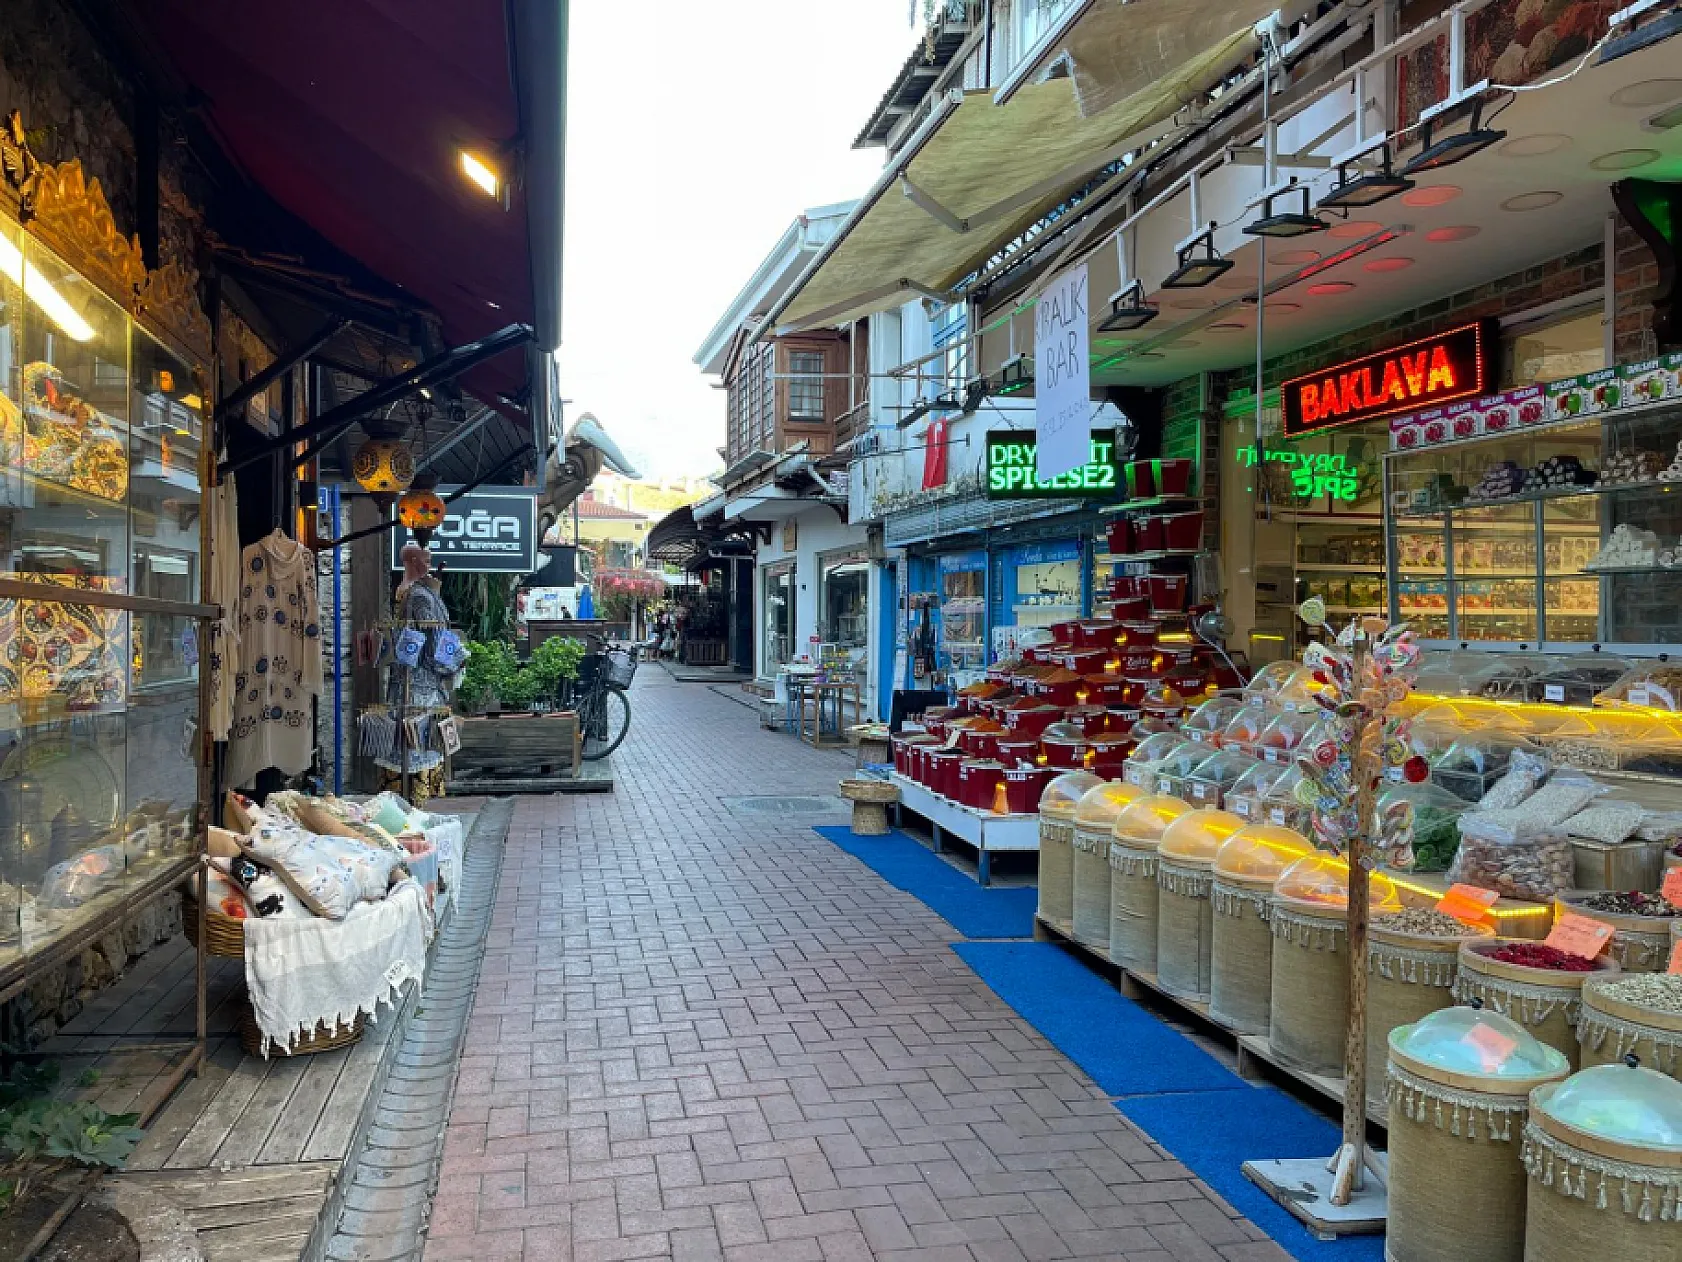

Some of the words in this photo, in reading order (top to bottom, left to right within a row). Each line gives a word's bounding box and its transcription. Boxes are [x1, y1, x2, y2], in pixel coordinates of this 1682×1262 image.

[1046, 330, 1079, 390] BAR
[1301, 346, 1455, 424] BAKLAVA
[406, 509, 520, 539] OĞA
